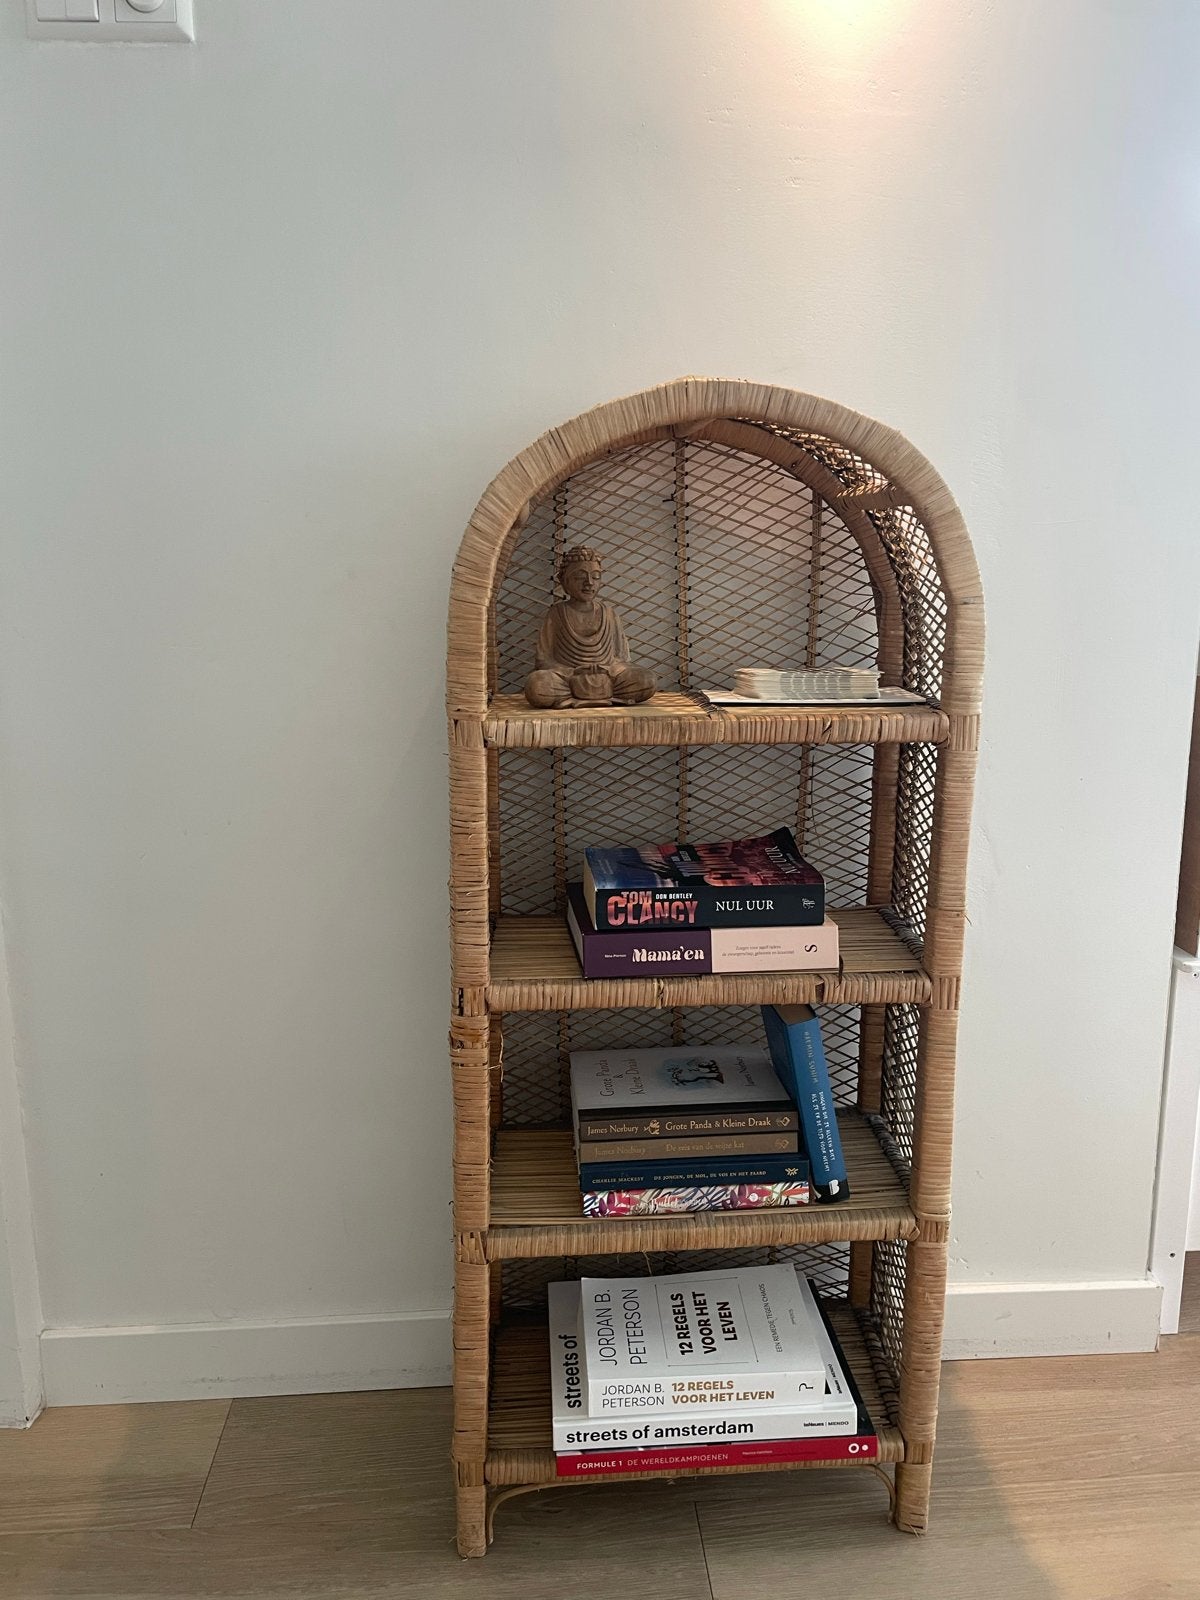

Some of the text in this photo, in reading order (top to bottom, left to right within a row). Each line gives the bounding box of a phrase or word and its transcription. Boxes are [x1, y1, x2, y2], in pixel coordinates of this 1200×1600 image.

[620, 890, 652, 905] TOM
[668, 892, 693, 900] BENTLEY
[607, 895, 698, 926] CLANCY
[716, 900, 774, 911] NUL UUR
[600, 1078, 615, 1097] Grote
[587, 1123, 639, 1136] James Norbury
[665, 1121, 688, 1131] Grote
[690, 1120, 712, 1129] Panda
[722, 1118, 746, 1128] Kleine
[748, 1116, 771, 1126] Draak
[595, 1147, 615, 1157] James
[666, 1143, 677, 1152] De
[758, 1283, 769, 1302] CHAOS
[764, 1302, 773, 1320] TEGEN
[594, 1289, 618, 1366] JORDAN B.
[621, 1288, 648, 1365] PETERSON
[670, 1292, 694, 1356] 12 REGELS
[691, 1291, 718, 1355] VOOR HET
[716, 1301, 738, 1341] LEVEN
[774, 1341, 783, 1353] EEN
[558, 1334, 582, 1408] streets of
[602, 1383, 665, 1396] JORDAN B.
[671, 1380, 734, 1392] 12 REGELS
[602, 1396, 665, 1409] PETERSON
[672, 1390, 775, 1404] VOOR HET LEVEN
[566, 1421, 754, 1444] streets of amsterdam
[577, 1460, 617, 1470] FORMULE
[627, 1459, 639, 1467] DE
[641, 1453, 729, 1466] WERELDKAMPIOENEN
